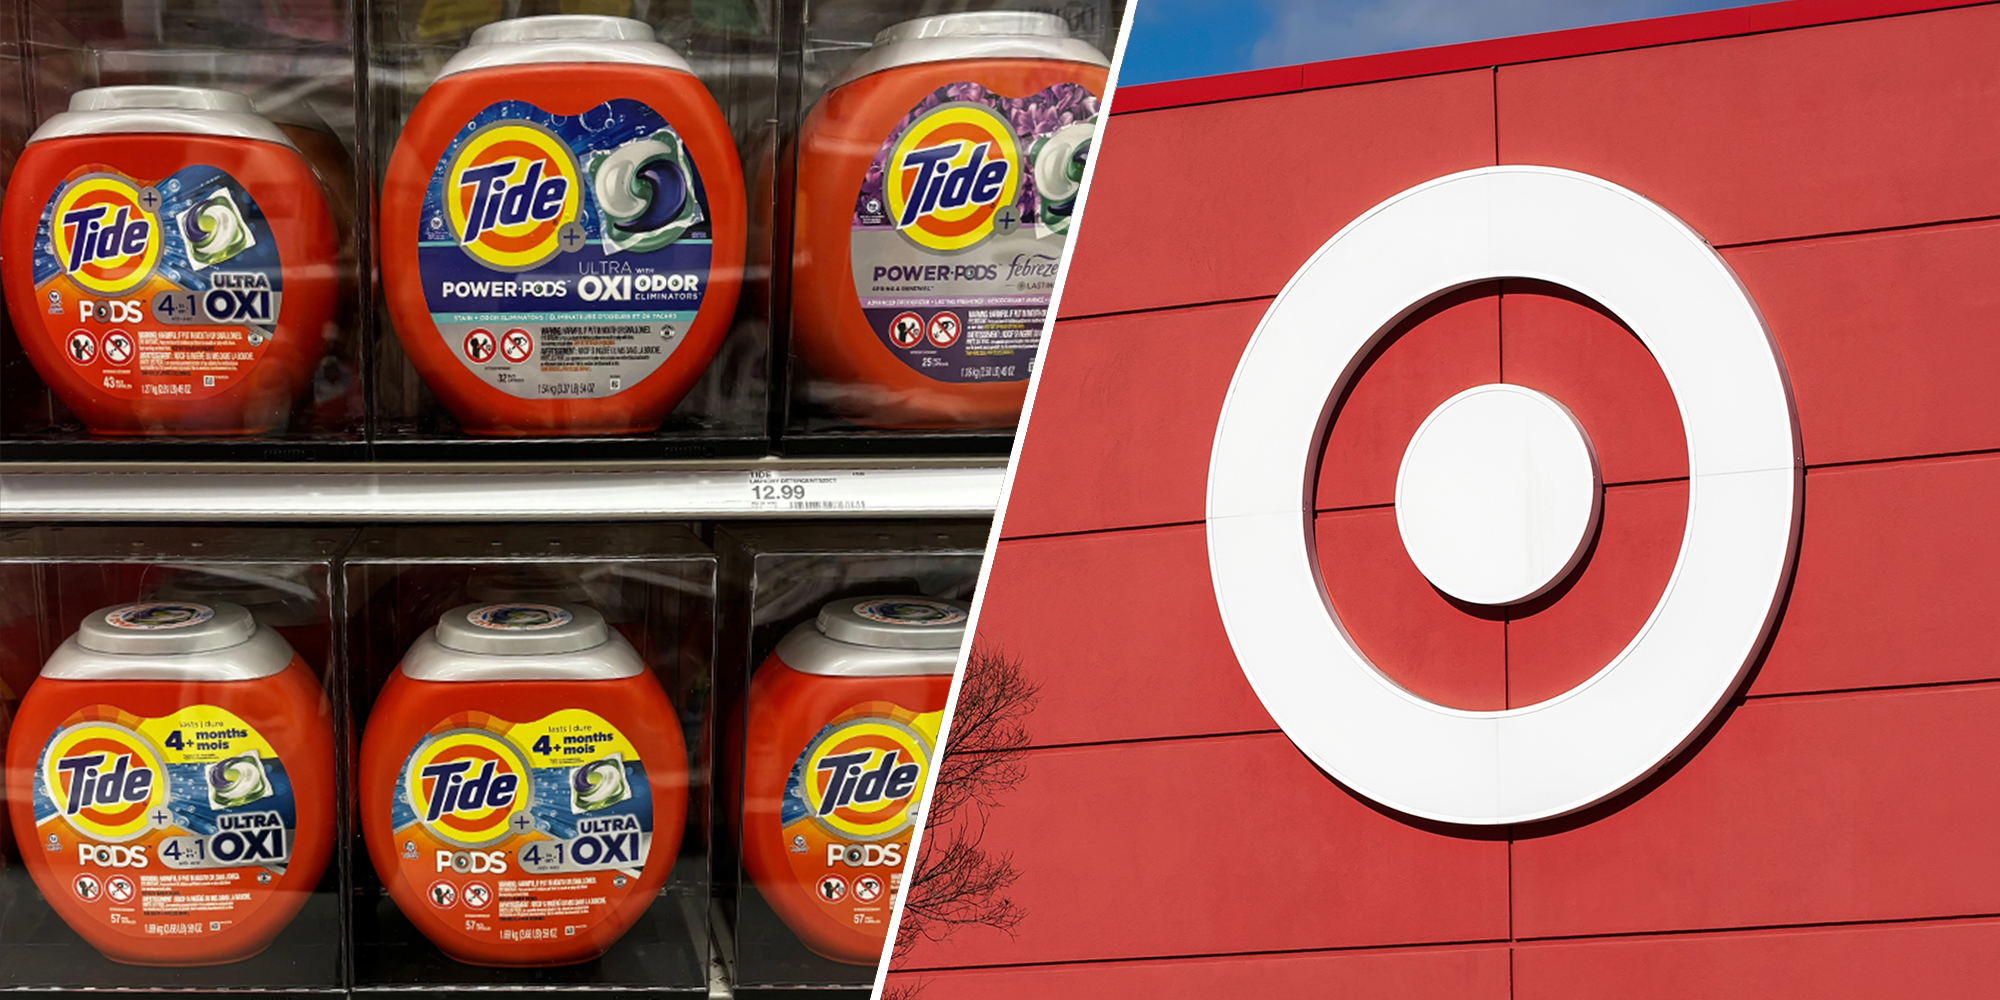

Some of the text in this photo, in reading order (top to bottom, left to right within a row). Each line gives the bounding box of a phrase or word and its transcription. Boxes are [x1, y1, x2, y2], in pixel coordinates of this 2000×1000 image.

[896, 141, 1010, 230] Tide
[458, 158, 569, 245] Tide
[61, 204, 150, 275] Tide
[579, 261, 632, 274] ULTRA
[1006, 254, 1059, 281] febreze
[213, 274, 269, 288] ULTRA
[577, 274, 699, 301] OXI ODOR
[80, 301, 143, 323] PODS
[205, 289, 271, 321] OXI
[103, 376, 115, 388] 43
[752, 485, 805, 500] 12.99
[196, 728, 248, 740] months
[197, 740, 229, 750] mois
[563, 732, 613, 744] months
[563, 744, 596, 755] mois
[55, 753, 154, 815] Tide
[420, 759, 519, 823] Tide
[815, 750, 921, 817] Tide
[219, 813, 280, 830] ULTRA
[580, 817, 638, 834] ULTRA
[78, 843, 148, 868] PODS
[211, 828, 284, 861] OXI
[571, 833, 639, 865] OXI
[827, 843, 902, 867] PODS
[436, 850, 507, 874] PODS
[111, 914, 121, 924] 57
[465, 920, 475, 930] 57
[854, 914, 864, 924] 57
